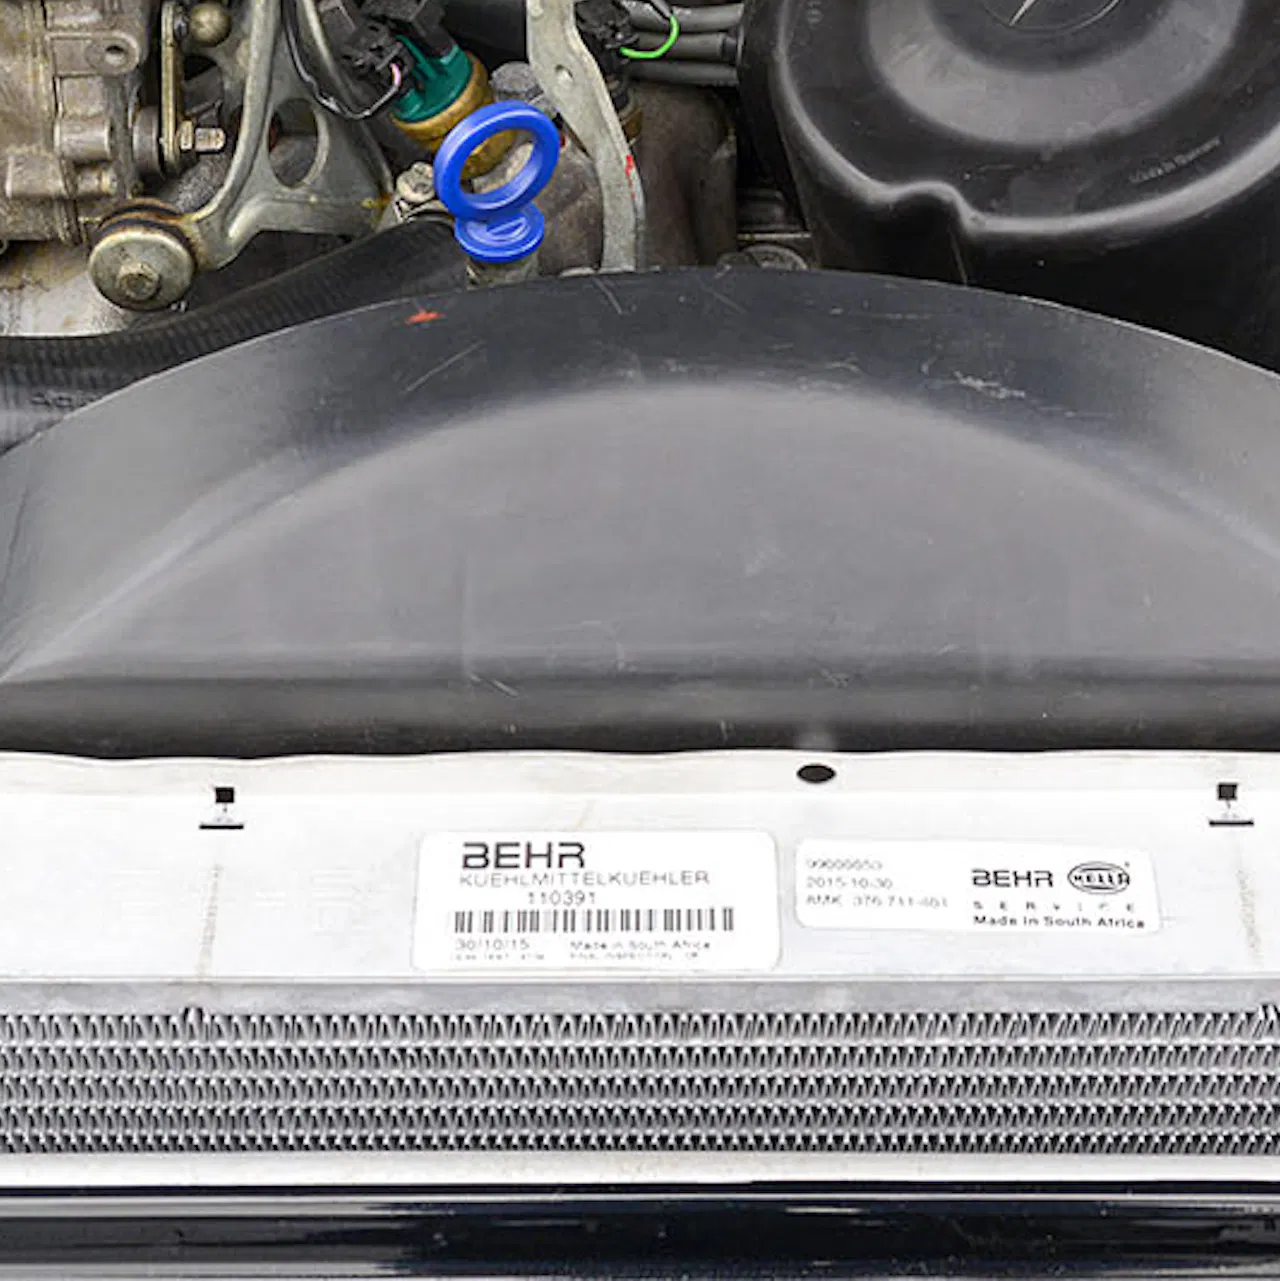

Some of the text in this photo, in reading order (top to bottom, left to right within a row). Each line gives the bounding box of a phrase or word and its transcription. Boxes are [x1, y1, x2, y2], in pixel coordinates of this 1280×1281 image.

[462, 841, 586, 869] BEHR
[459, 871, 710, 888] KUEHLMITTELKUEHLER
[972, 869, 1054, 888] BEHR
[1072, 871, 1131, 887] HELLA
[527, 889, 597, 906] 110391
[973, 915, 1147, 930] Made in South Africa
